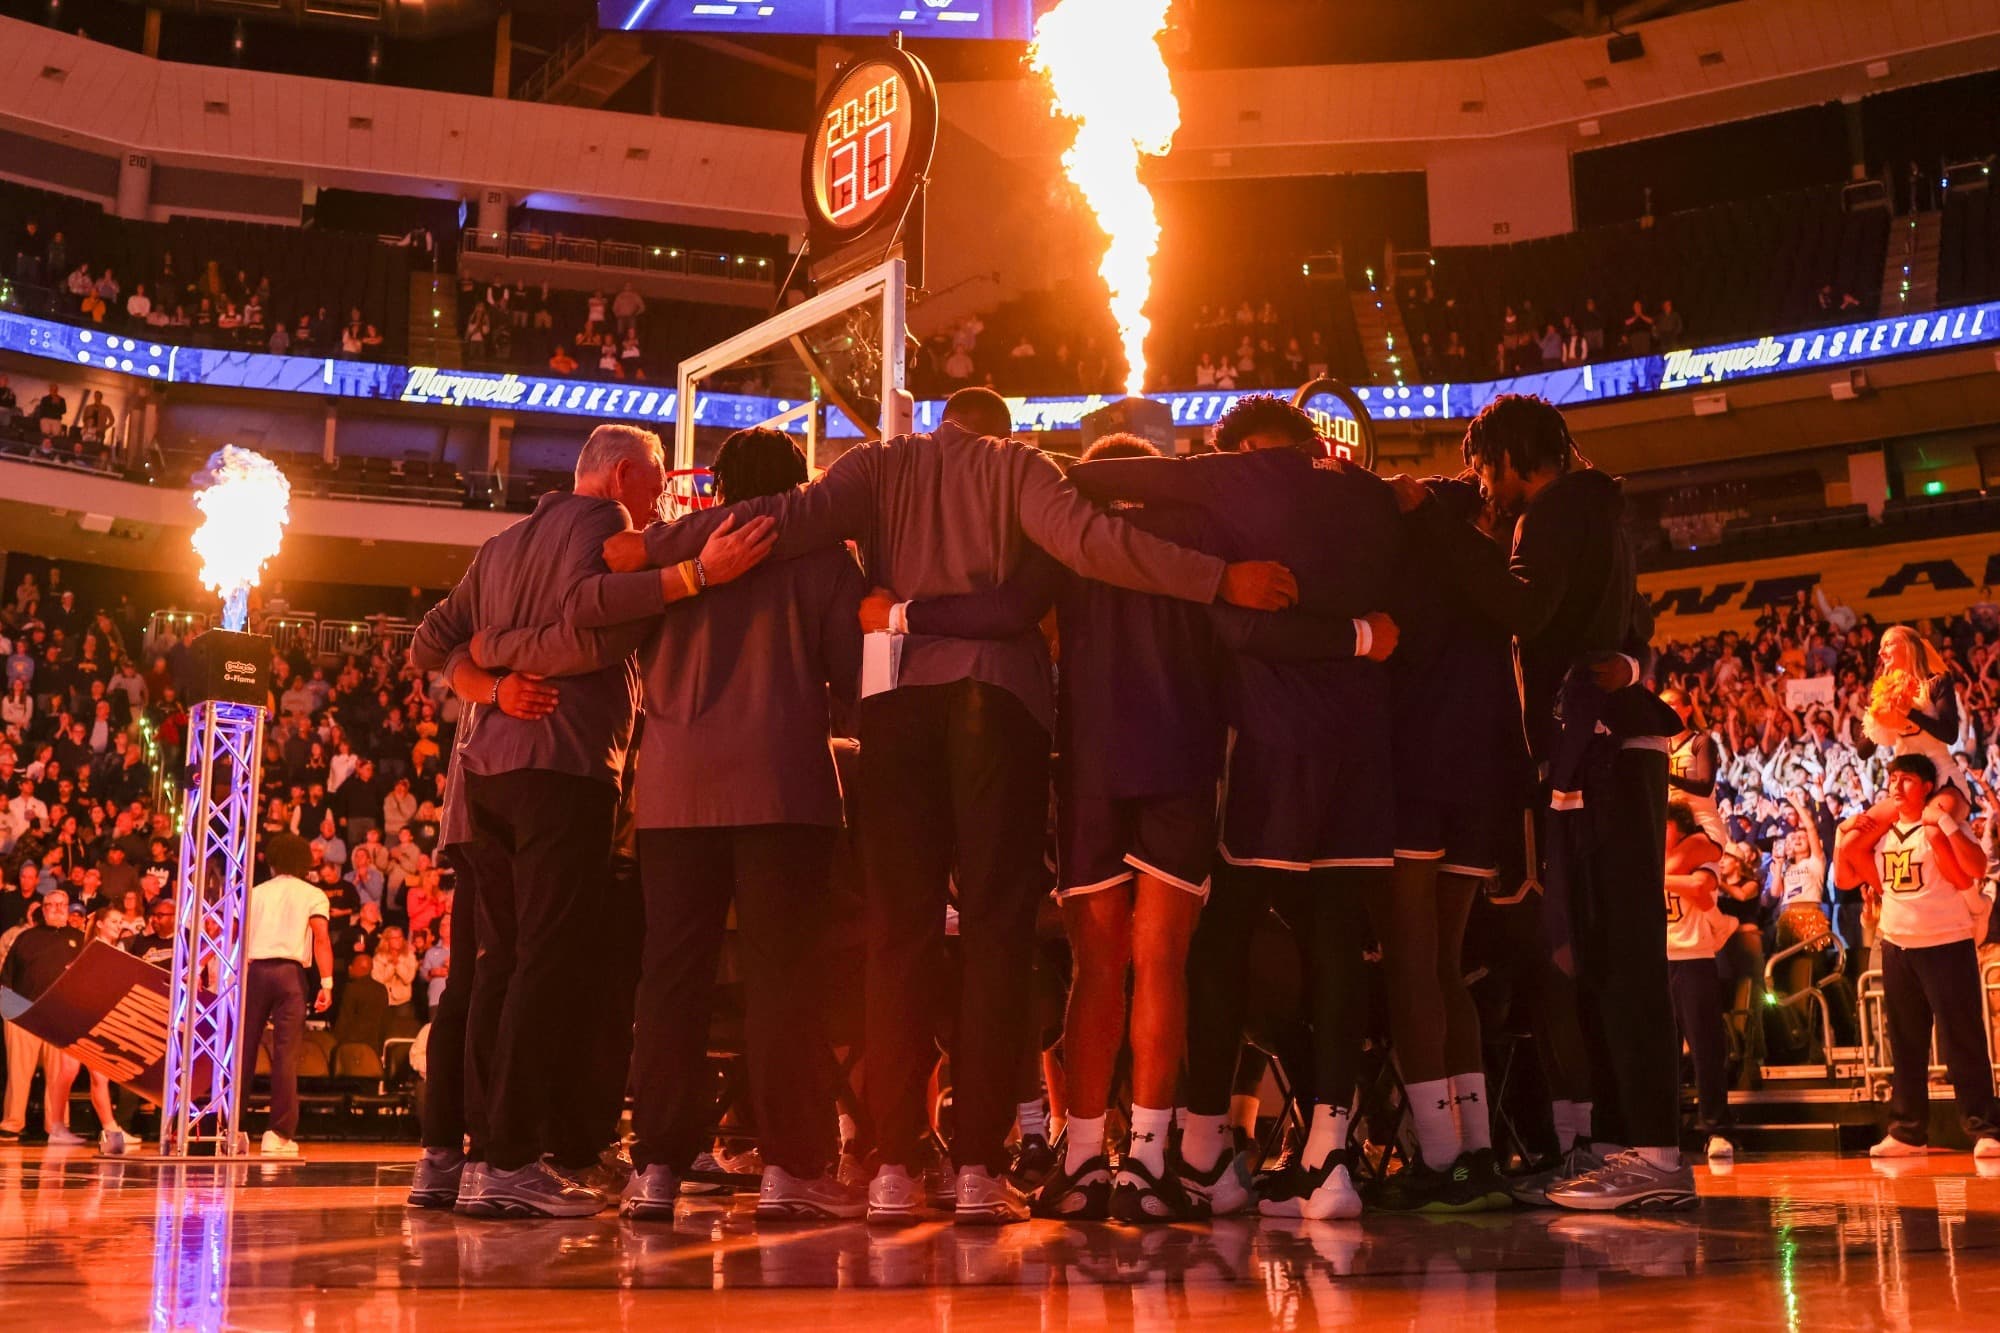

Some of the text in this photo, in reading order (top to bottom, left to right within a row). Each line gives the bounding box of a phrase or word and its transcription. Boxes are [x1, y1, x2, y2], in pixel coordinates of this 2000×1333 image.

[827, 75, 897, 148] 20:00
[129, 154, 147, 169] 210
[831, 121, 891, 218] 30
[1660, 310, 1985, 384] Marquette BASKETBALL
[402, 366, 708, 420] Marquette BASKETBAL
[223, 673, 256, 684] G-Flame
[1881, 848, 1924, 893] MU
